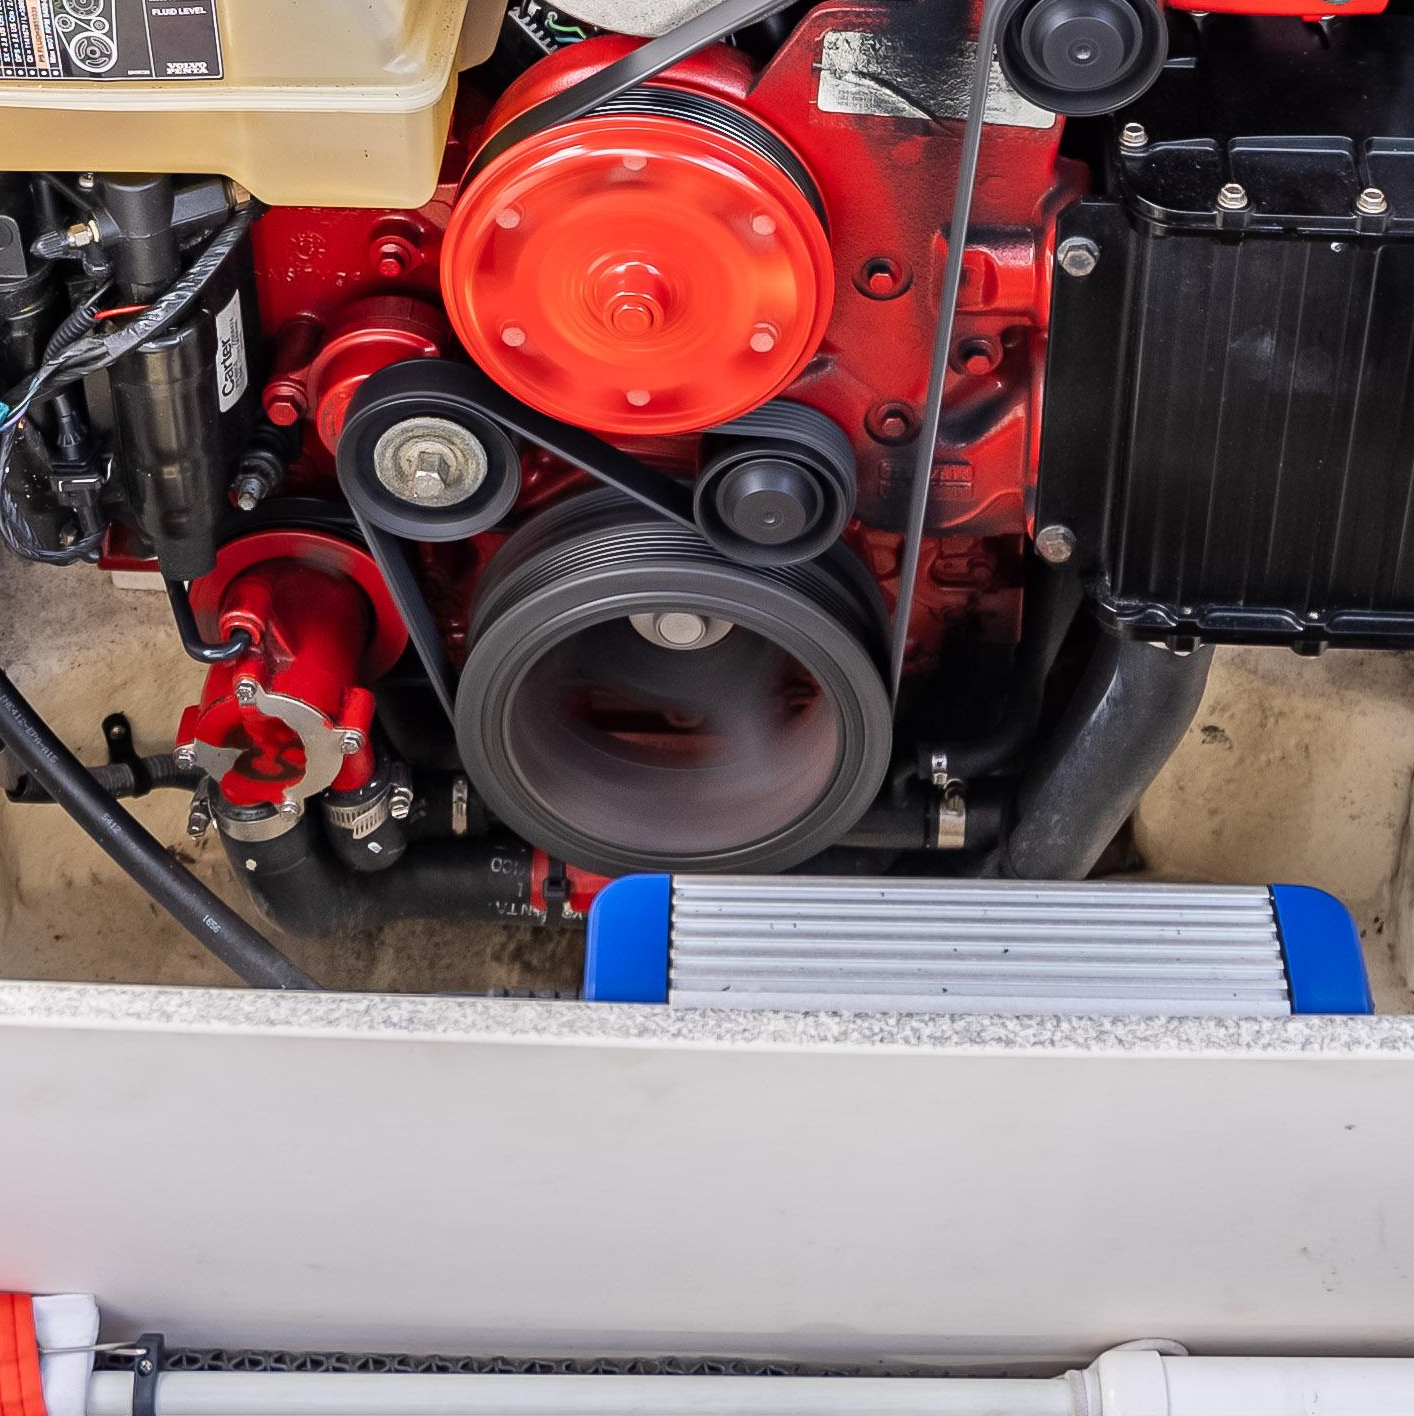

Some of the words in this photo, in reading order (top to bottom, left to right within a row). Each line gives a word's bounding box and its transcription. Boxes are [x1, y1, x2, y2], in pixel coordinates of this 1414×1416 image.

[151, 7, 177, 16] FLUID
[178, 6, 207, 15] LEVEL
[220, 337, 235, 398] Carter
